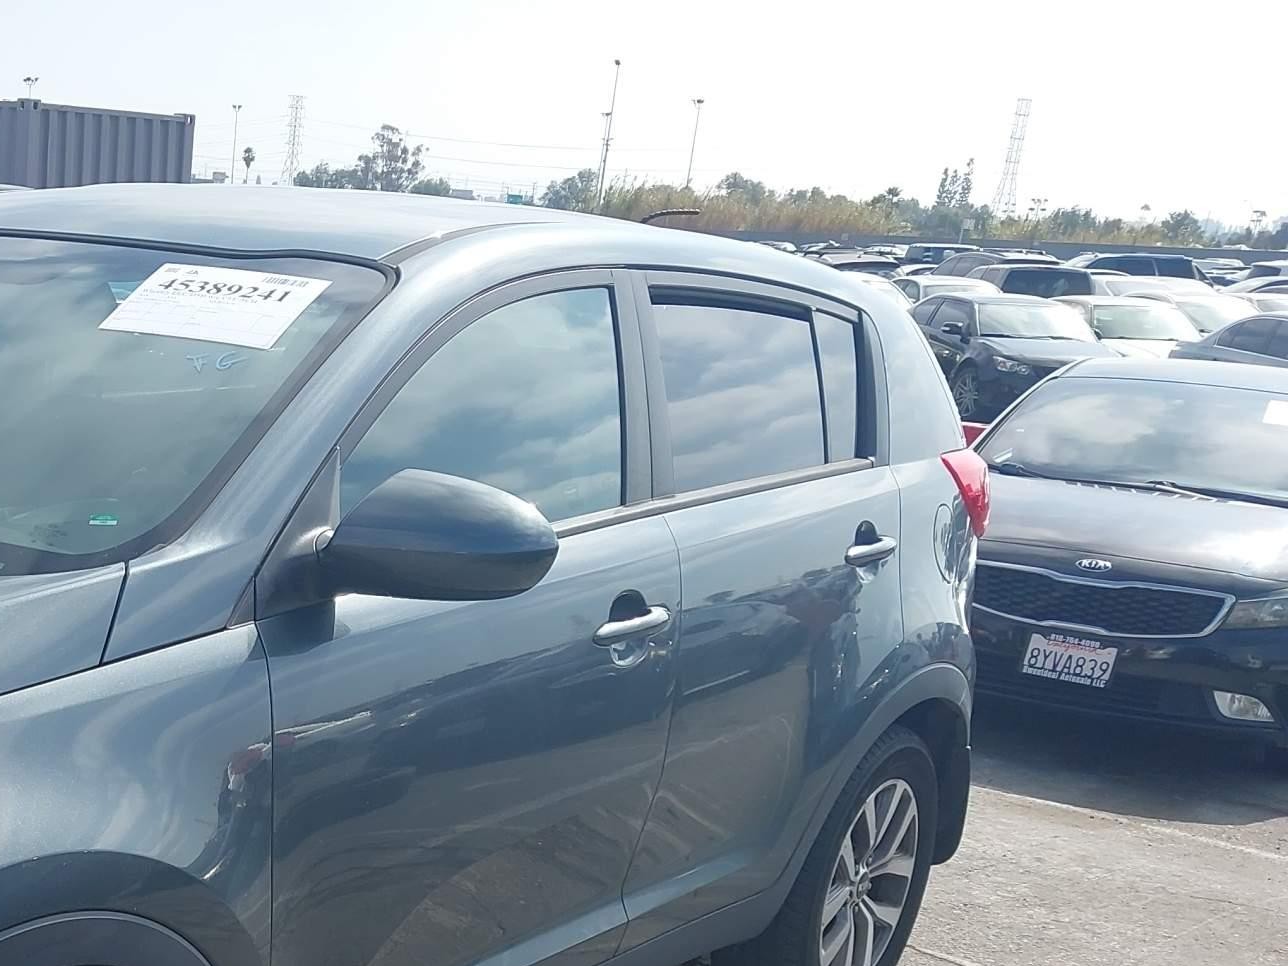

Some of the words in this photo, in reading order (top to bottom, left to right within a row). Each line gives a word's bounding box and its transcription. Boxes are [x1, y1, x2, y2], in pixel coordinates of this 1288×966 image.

[158, 278, 292, 303] 45389241
[1078, 558, 1109, 571] KIA
[1027, 647, 1111, 681] 8YVA839
